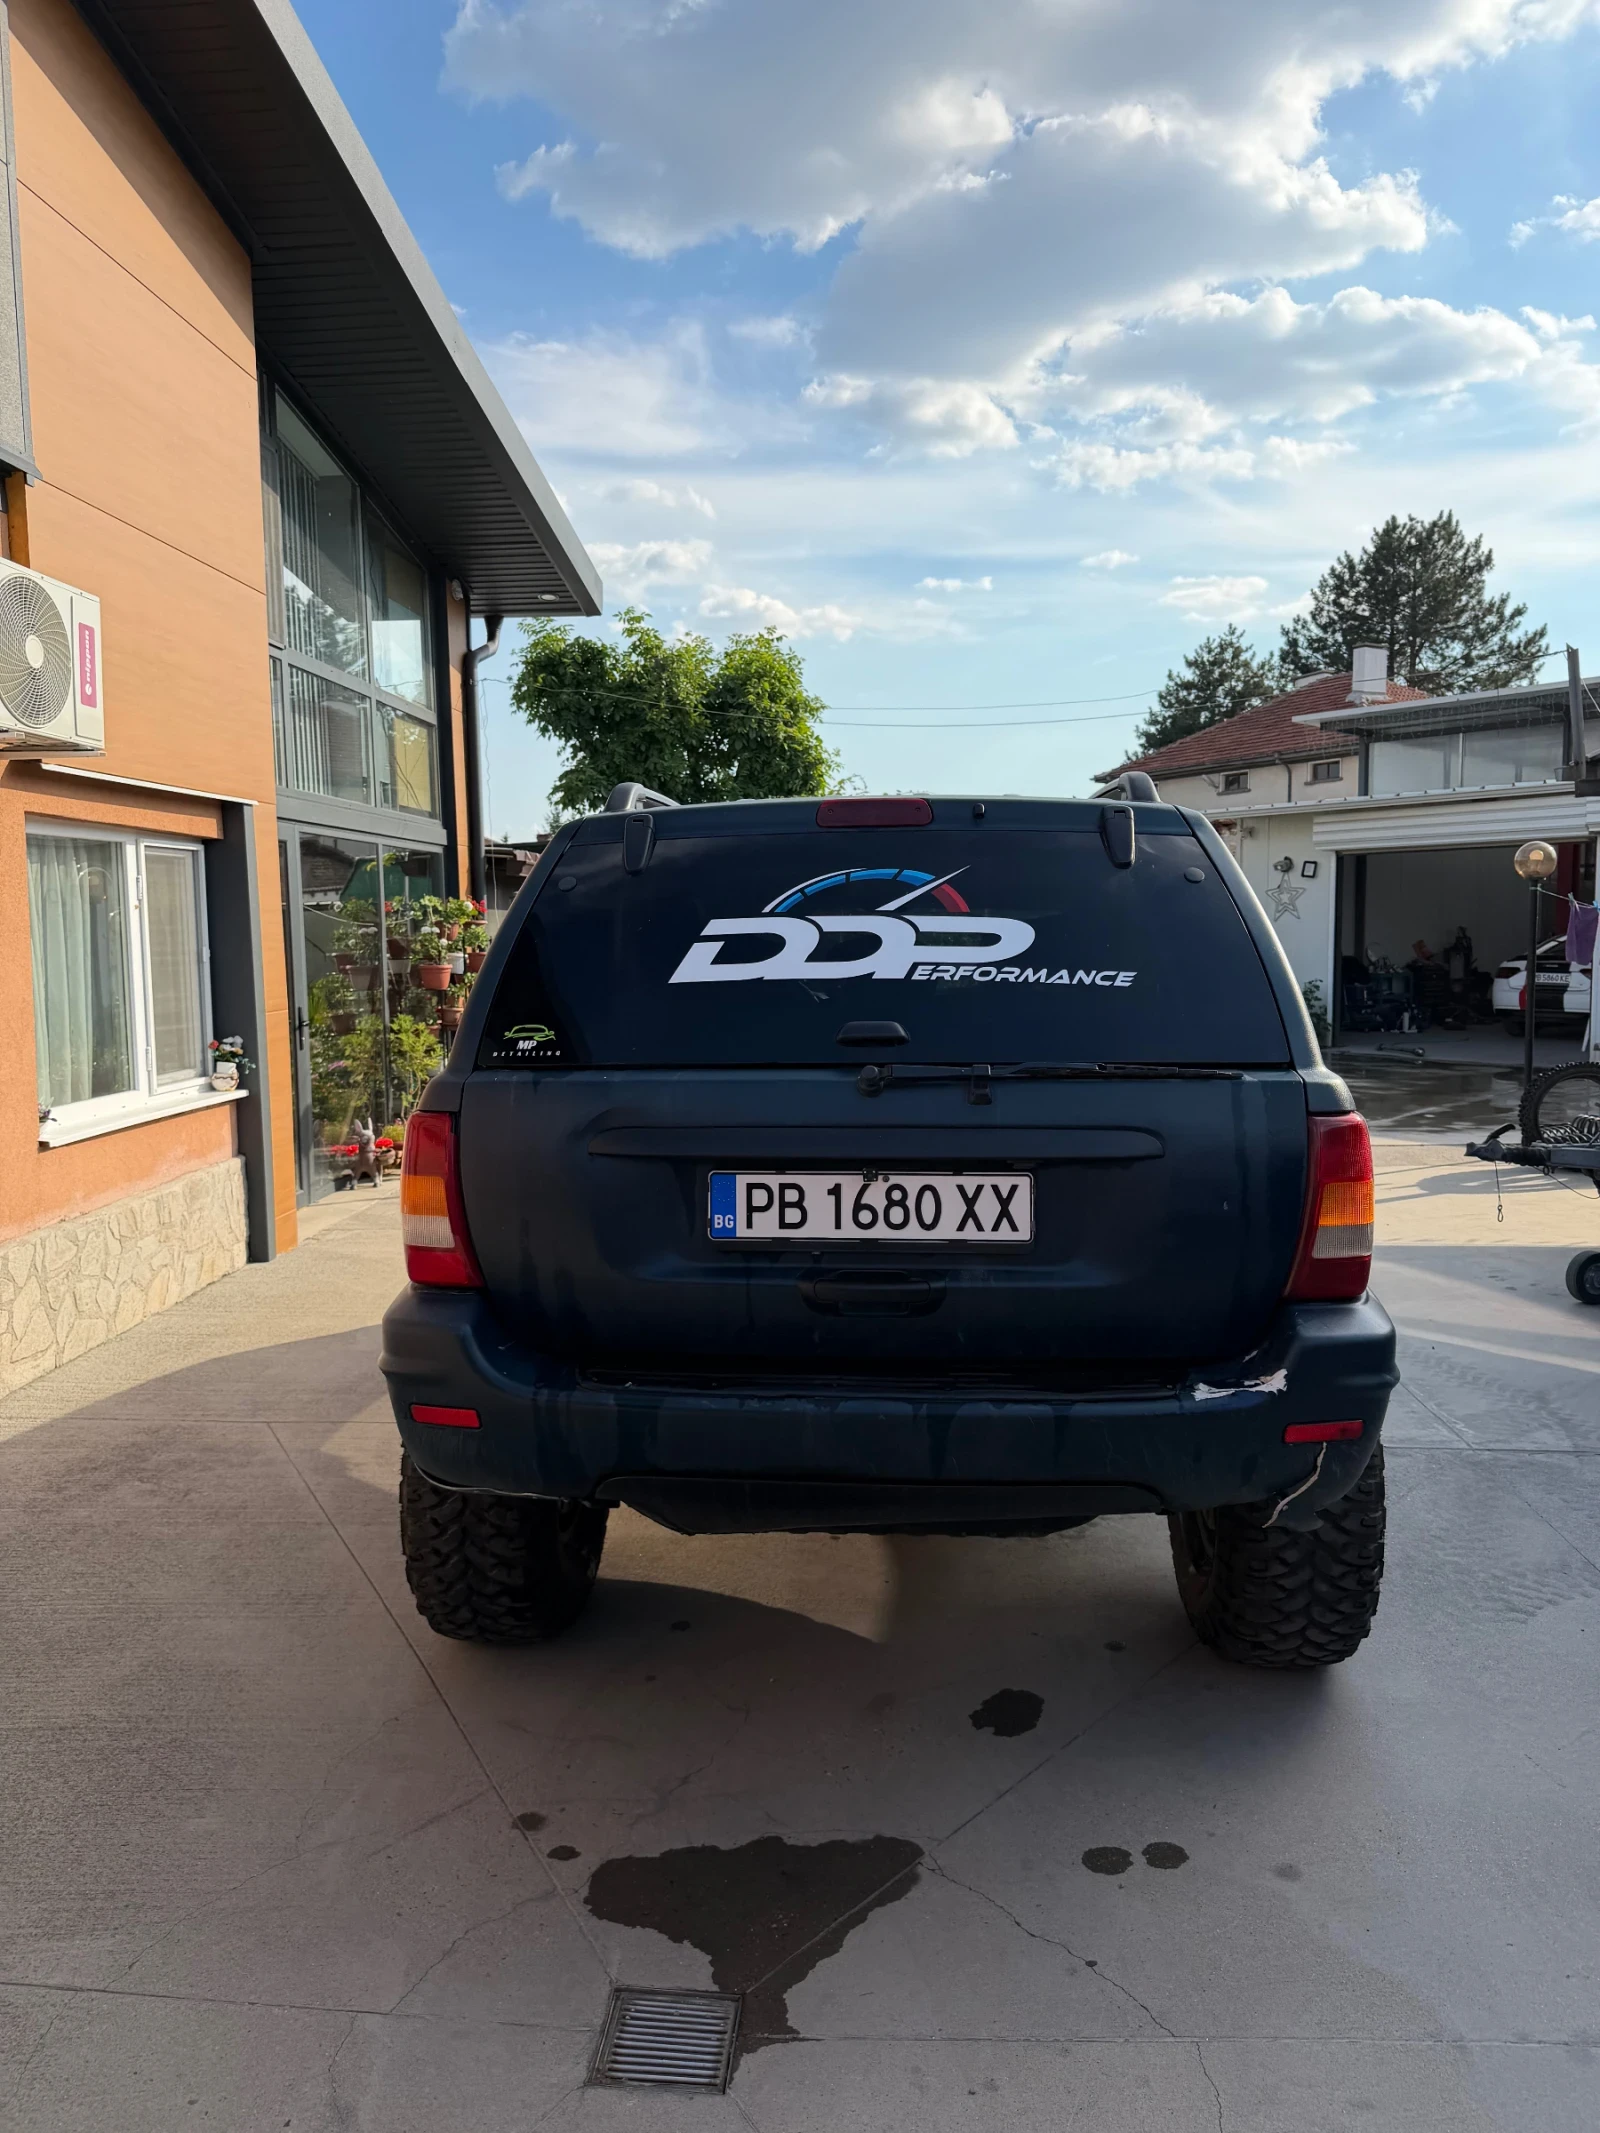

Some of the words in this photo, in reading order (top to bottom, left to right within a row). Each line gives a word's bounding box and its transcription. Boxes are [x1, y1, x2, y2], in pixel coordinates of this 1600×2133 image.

[516, 1040, 537, 1050] MP
[746, 1182, 808, 1230] PB
[827, 1182, 942, 1232] 1680
[956, 1183, 1020, 1232] XX
[714, 1214, 734, 1229] BG
